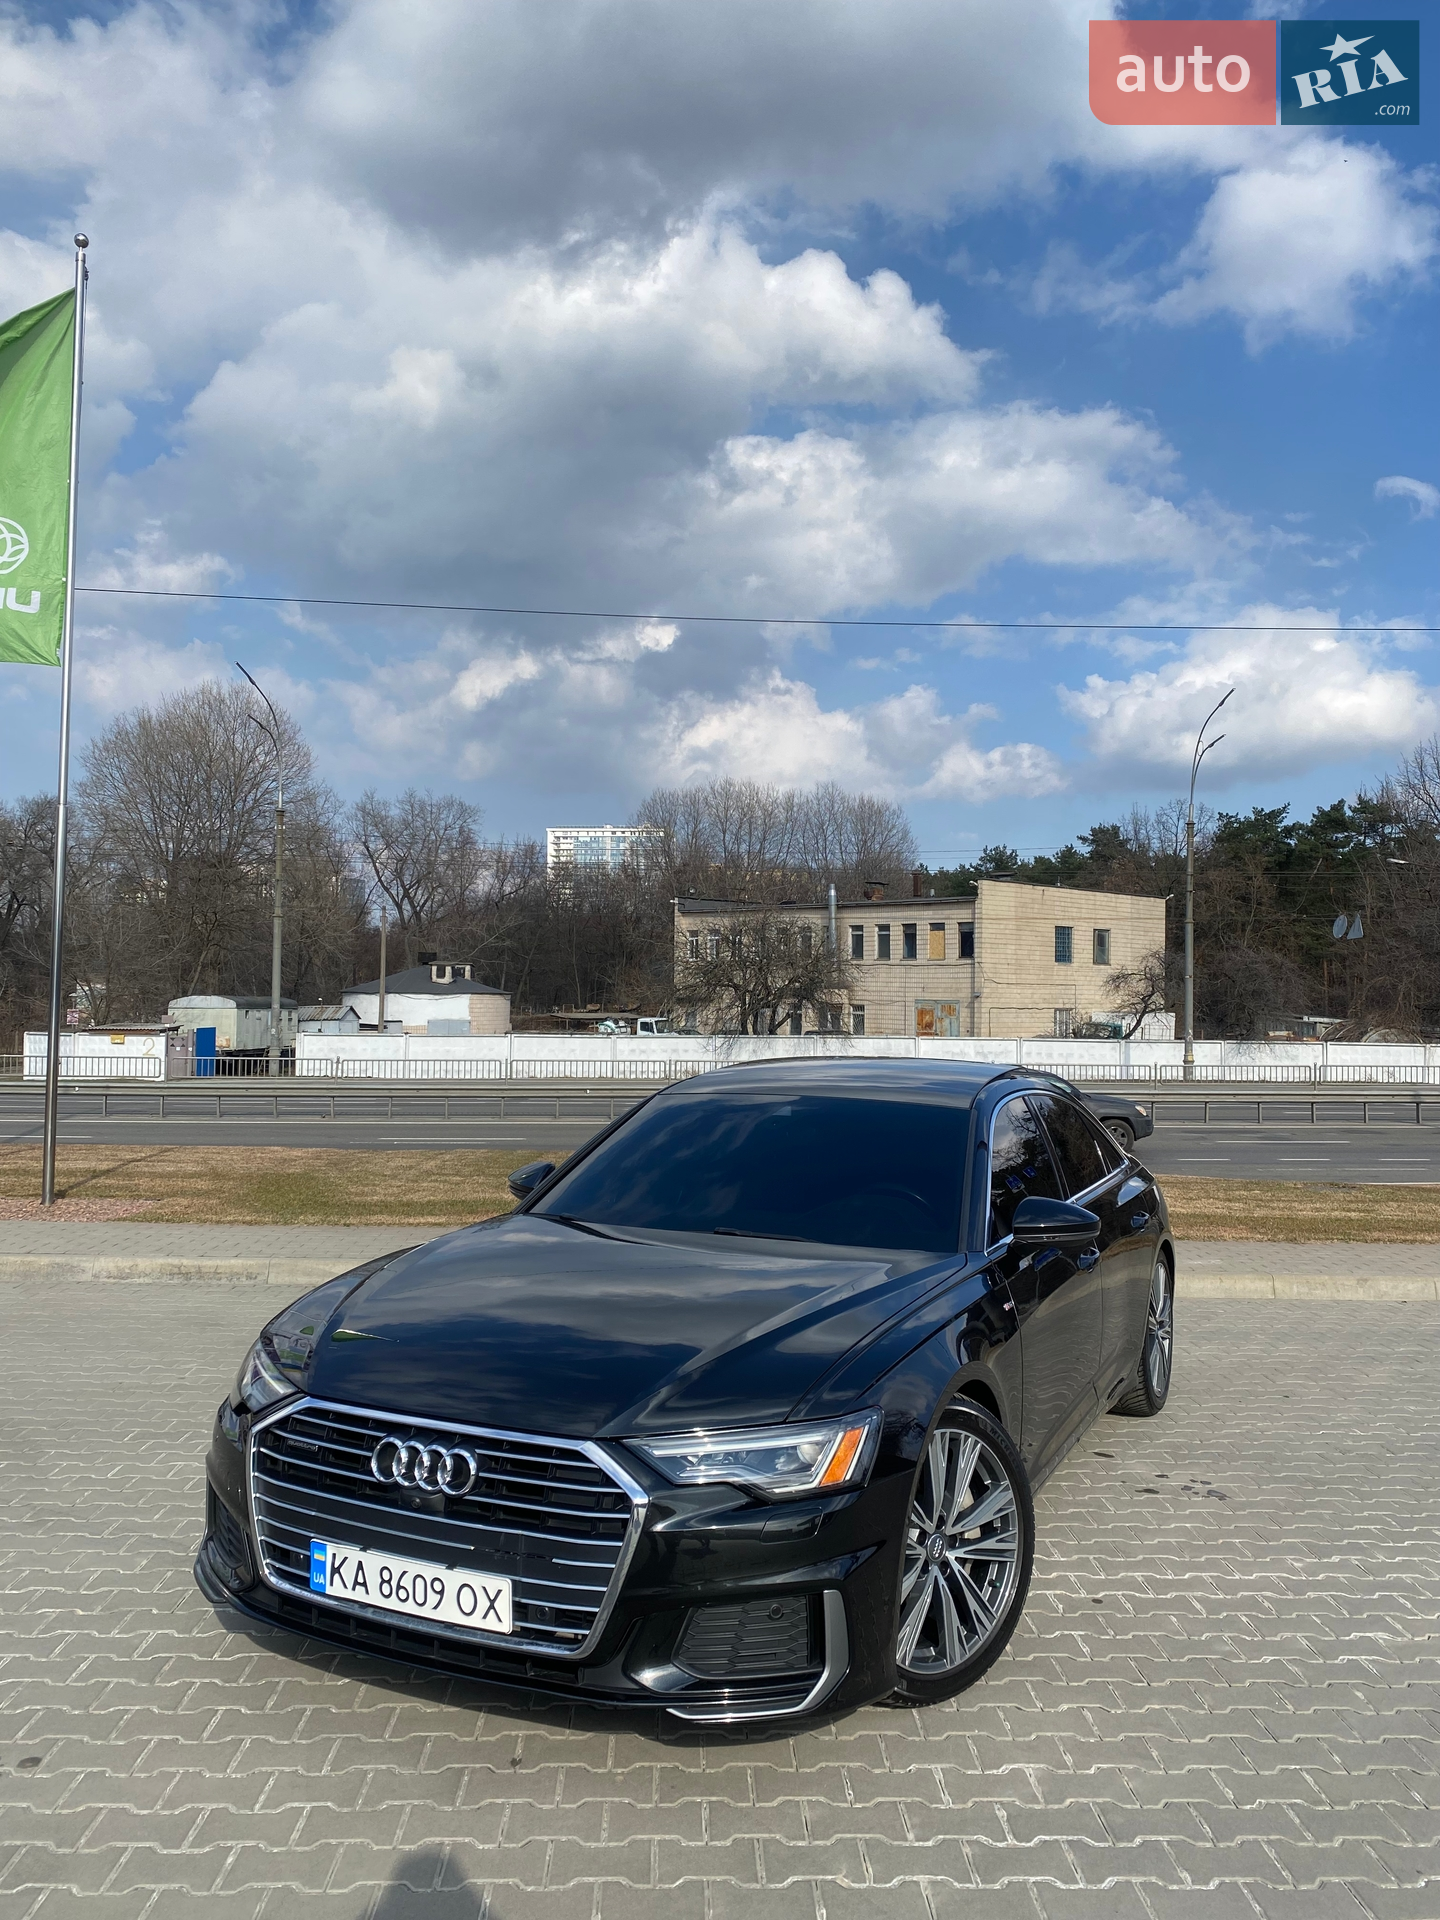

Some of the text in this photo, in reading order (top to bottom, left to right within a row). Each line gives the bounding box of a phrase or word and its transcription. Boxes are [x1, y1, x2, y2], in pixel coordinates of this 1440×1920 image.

[142, 1037, 155, 1056] 2
[313, 1571, 325, 1585] UA
[329, 1552, 503, 1623] KA 8609 OX
